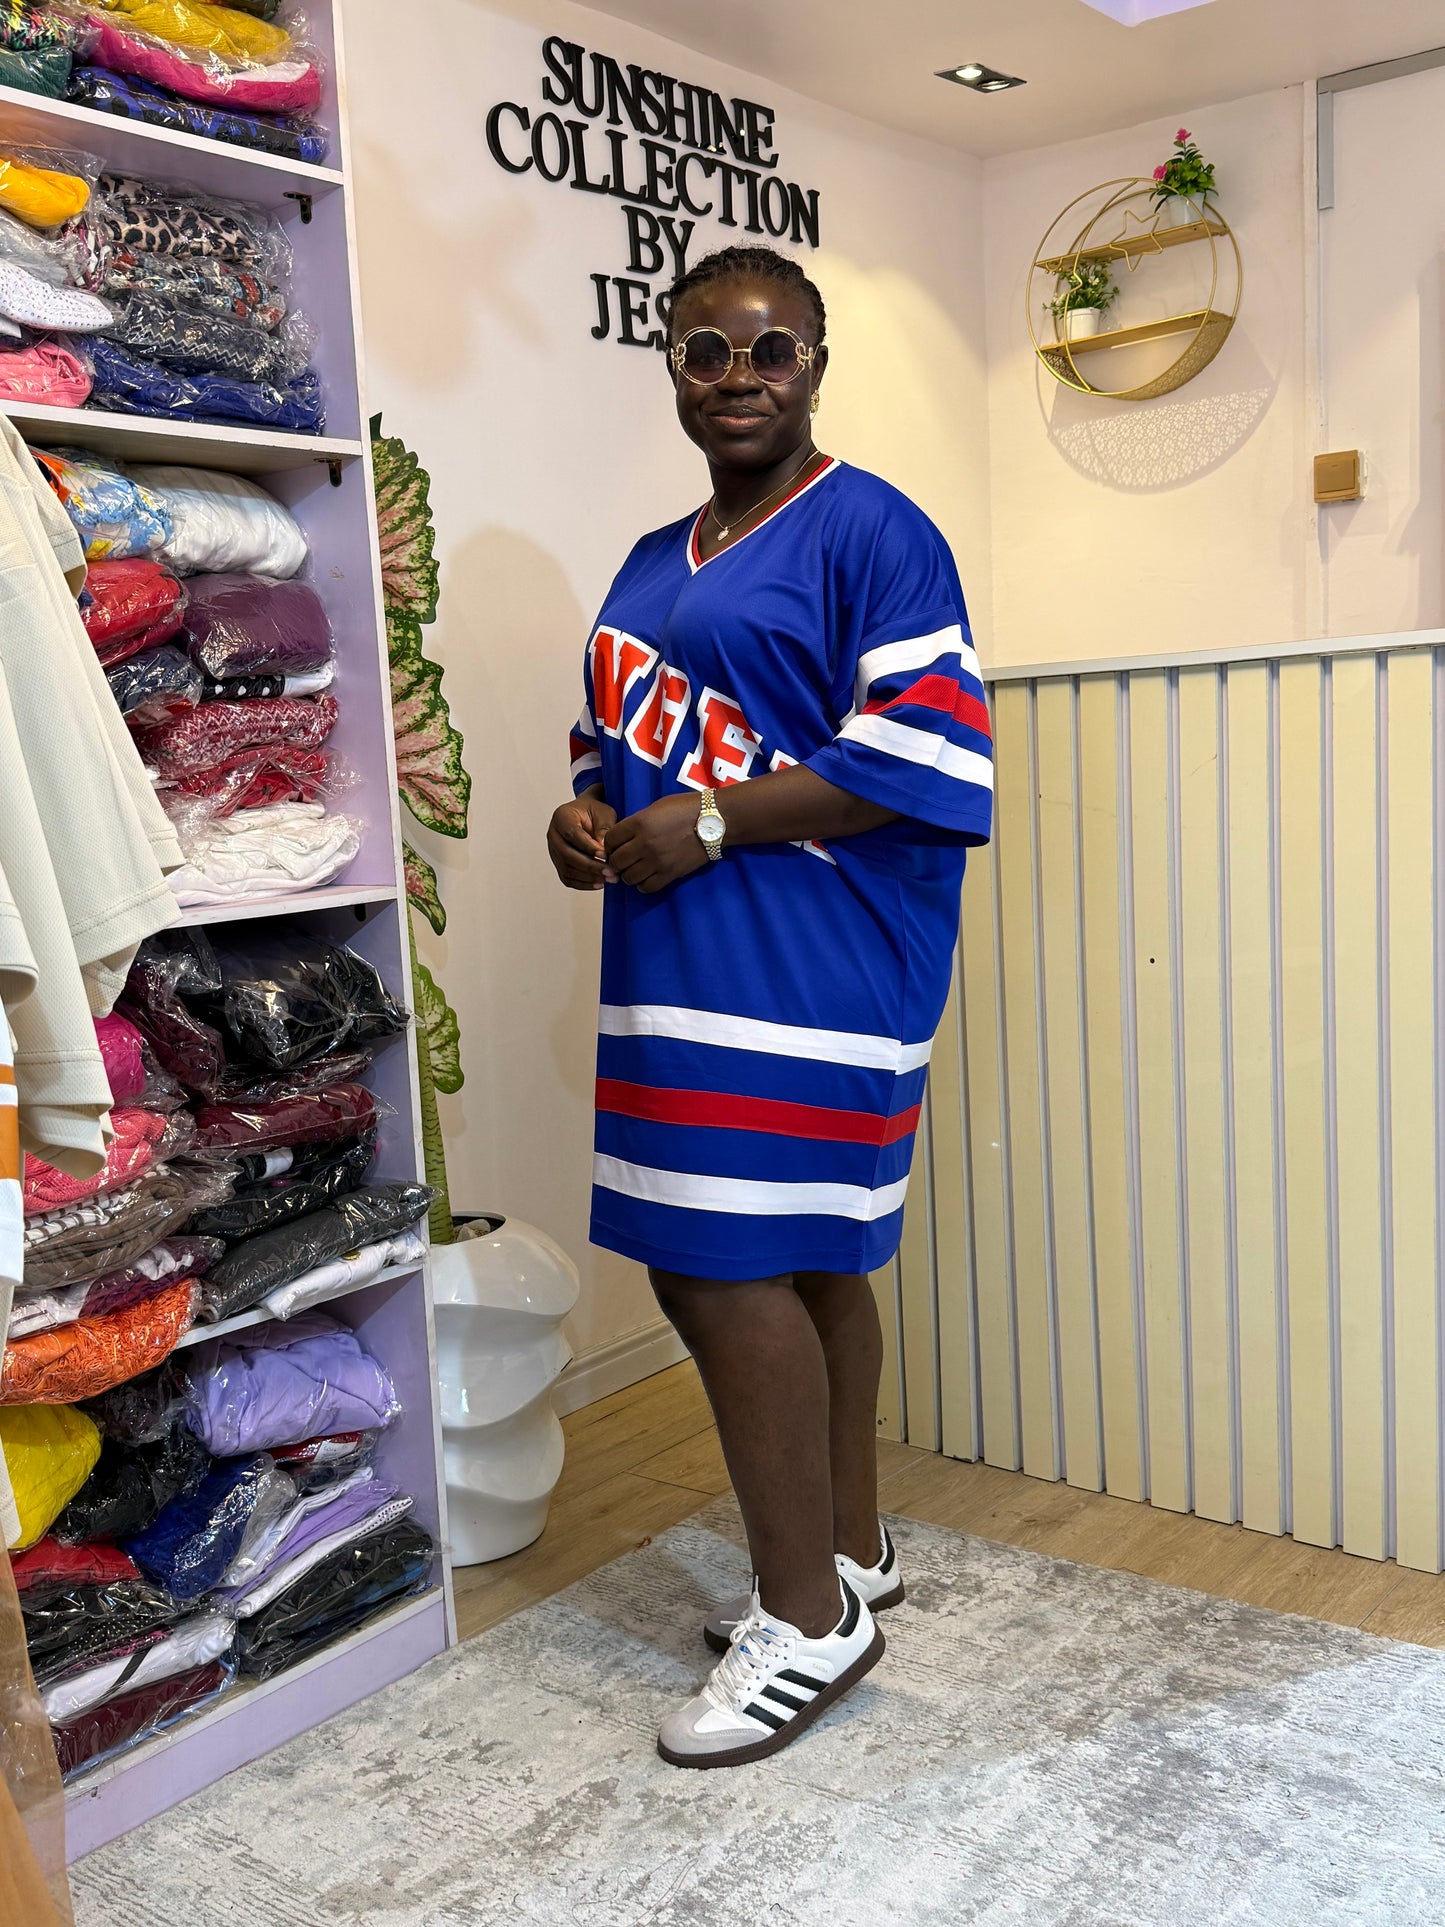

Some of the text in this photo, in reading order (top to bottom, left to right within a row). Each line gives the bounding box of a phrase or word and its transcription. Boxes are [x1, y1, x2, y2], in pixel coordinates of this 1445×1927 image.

[542, 36, 779, 168] SUNSHINE
[486, 102, 820, 248] COLLECTION
[621, 205, 695, 281] BY
